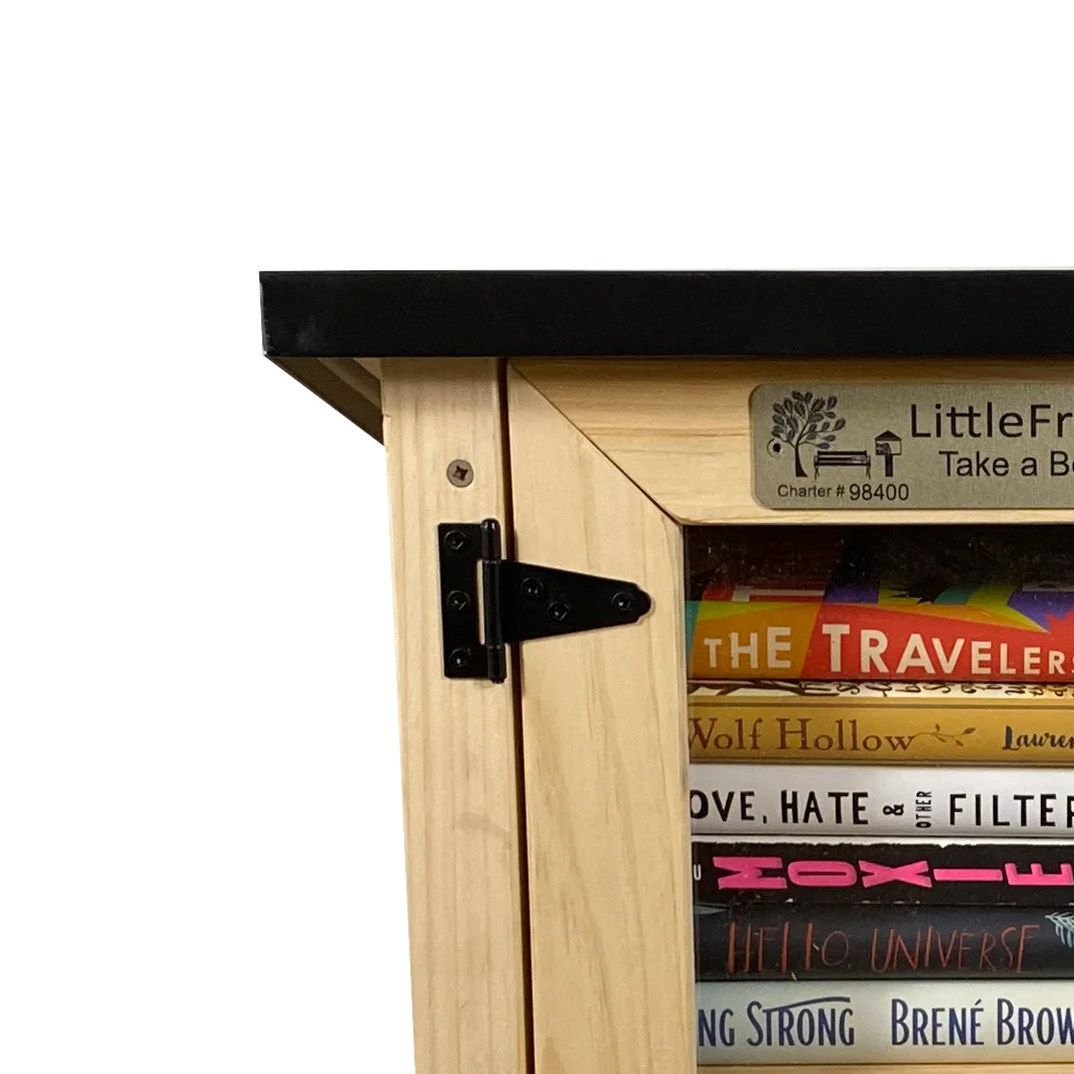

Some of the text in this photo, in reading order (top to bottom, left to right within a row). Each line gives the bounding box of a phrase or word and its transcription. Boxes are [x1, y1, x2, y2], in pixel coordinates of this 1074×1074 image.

[938, 450, 1009, 477] Take
[1020, 456, 1038, 477] a
[777, 483, 909, 501] Charter # 98400
[703, 626, 792, 669] THE
[688, 717, 763, 751] Wolf
[776, 718, 916, 754] Hollow
[781, 789, 869, 825] HATE
[916, 790, 932, 828] OTHER
[712, 856, 1074, 891] MOXIE
[869, 925, 1040, 974] UNIVERSE
[747, 996, 855, 1047] STRONG
[892, 999, 985, 1046] BRENÉ
